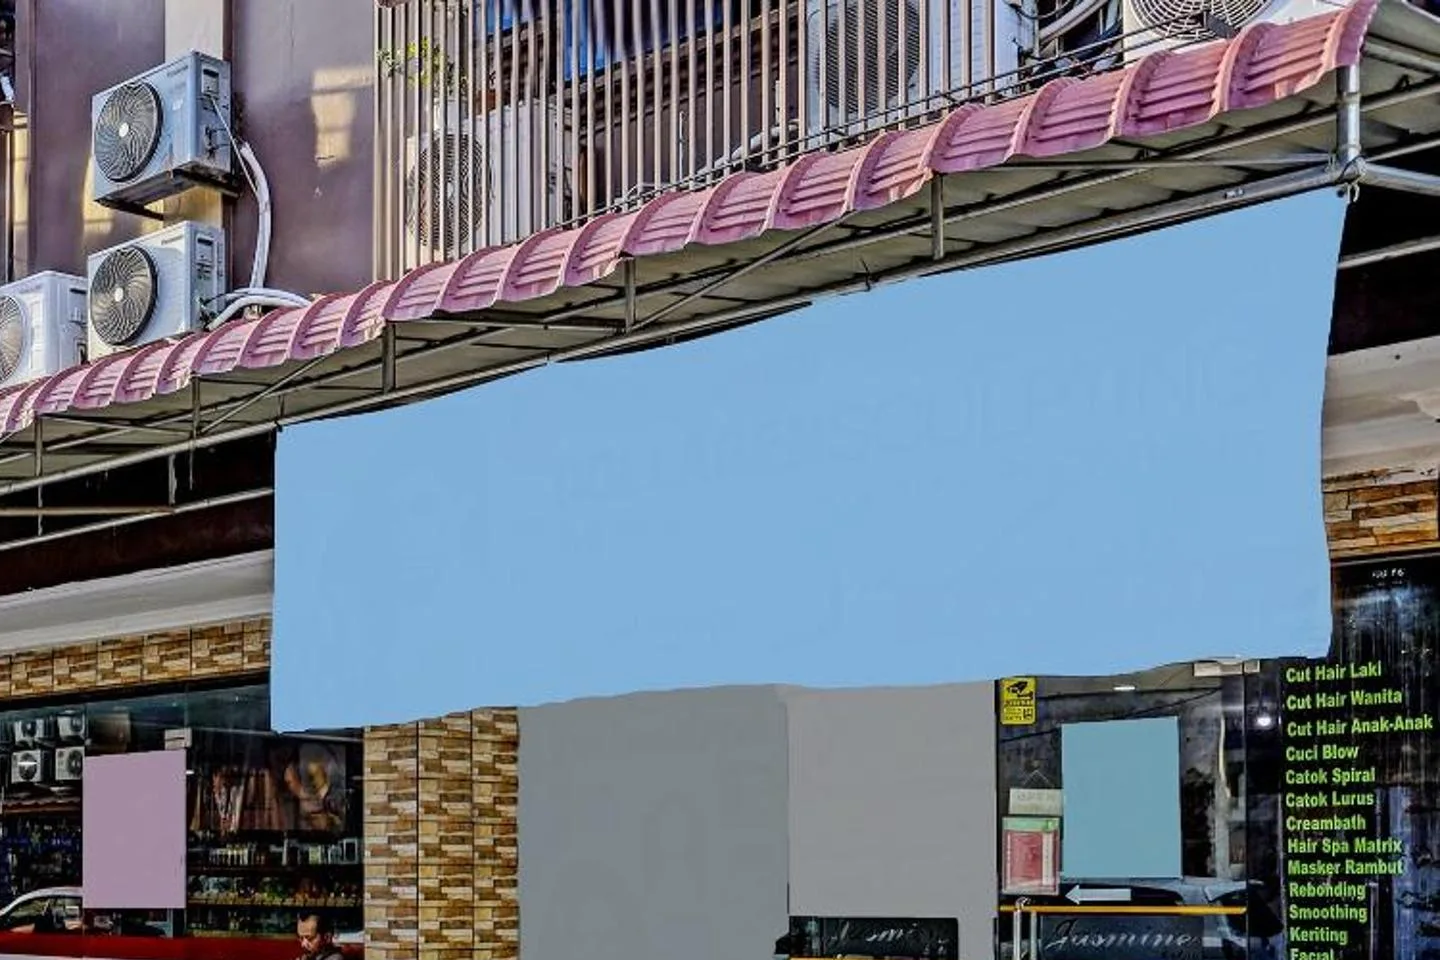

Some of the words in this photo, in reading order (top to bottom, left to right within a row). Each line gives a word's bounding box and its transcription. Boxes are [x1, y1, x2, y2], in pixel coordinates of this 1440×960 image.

[1286, 668, 1311, 683] Cut
[1315, 664, 1345, 681] Hair
[1350, 660, 1382, 677] Laki
[1286, 695, 1312, 710] Cut
[1316, 692, 1347, 708] Hair
[1350, 688, 1403, 706] Wanita
[1287, 721, 1312, 737] Cut
[1317, 719, 1348, 735] Hair
[1351, 714, 1433, 734] Anak-Anak
[1286, 746, 1318, 761] Cuci
[1322, 744, 1359, 759] Blow
[1286, 770, 1328, 785] Catok
[1331, 766, 1376, 786] Spiral
[1286, 792, 1328, 807] Catok
[1332, 790, 1374, 806] Lurus
[1286, 814, 1366, 831] Creambath
[1287, 837, 1318, 853] Hair
[1322, 838, 1349, 856] Spa
[1356, 836, 1403, 853] Matrix
[1288, 860, 1341, 875] Masker
[1345, 859, 1403, 875] Rambut
[1289, 882, 1366, 899] Rebonding
[1289, 904, 1368, 922] Smoothing
[1290, 927, 1348, 945] Keriting
